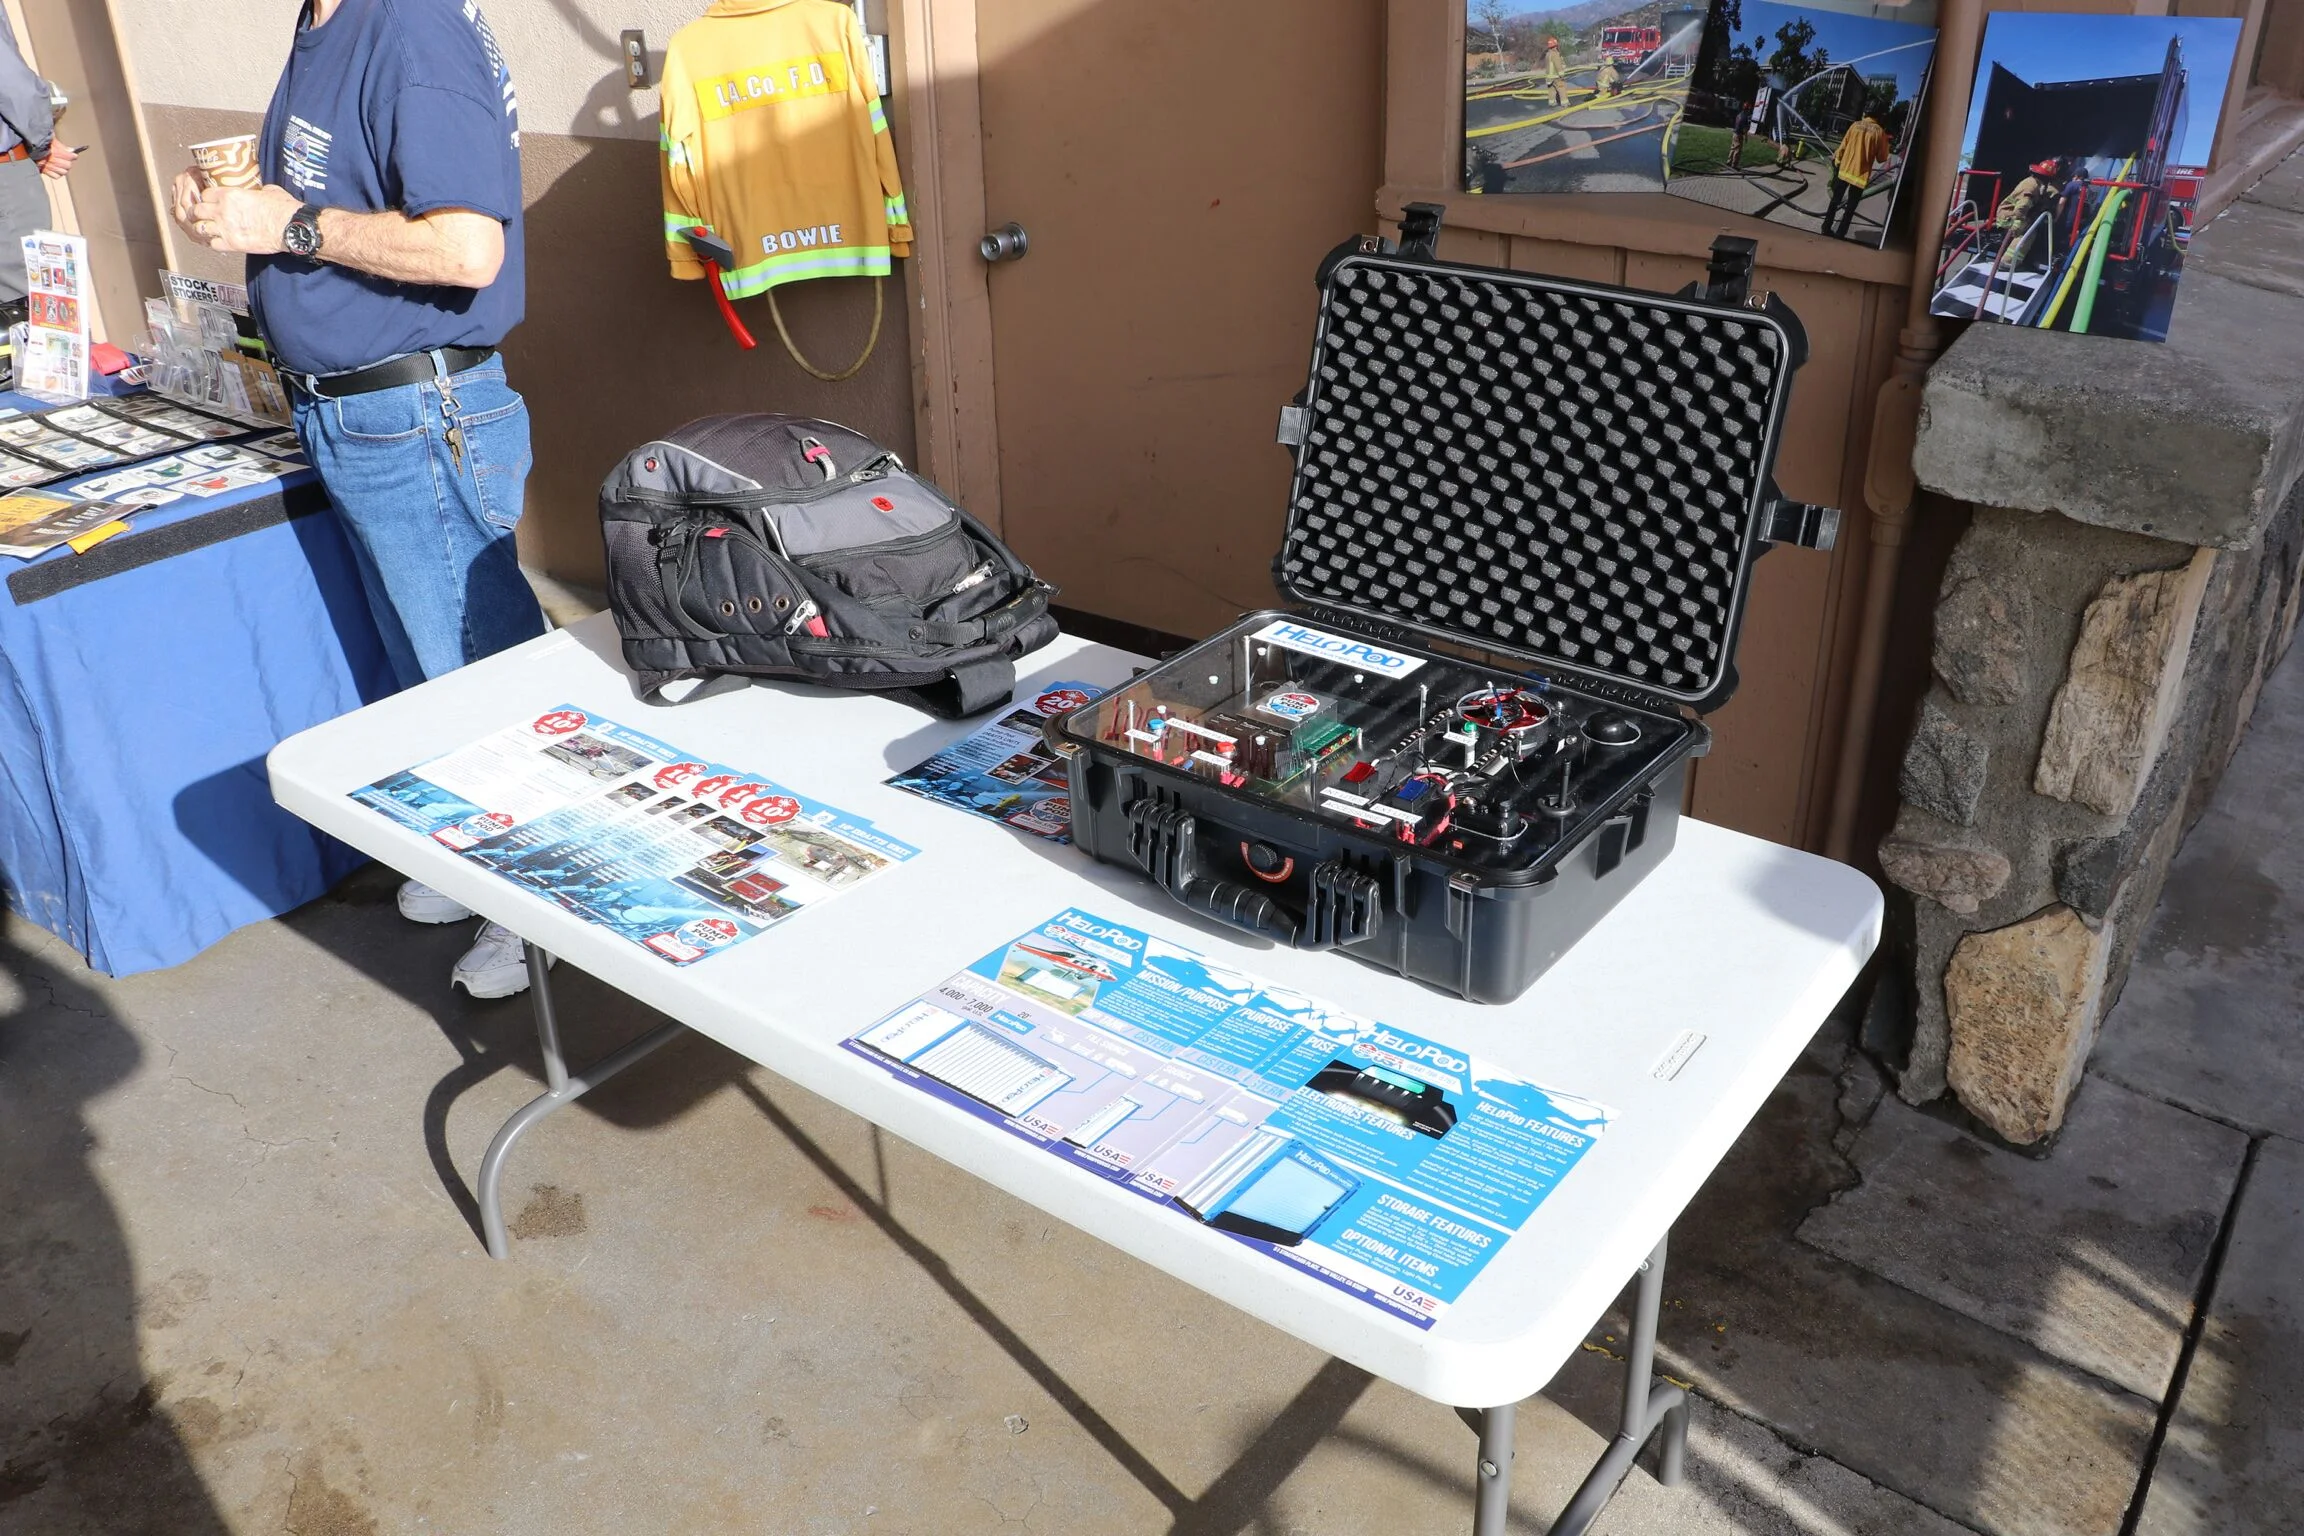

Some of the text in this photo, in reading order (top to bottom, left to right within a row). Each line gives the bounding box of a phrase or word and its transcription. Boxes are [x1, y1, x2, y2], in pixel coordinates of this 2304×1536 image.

[761, 224, 843, 254] BOWIE
[170, 276, 210, 292] STOCK
[173, 287, 215, 303] STICKERS
[541, 715, 581, 729] 10'
[1002, 737, 1021, 745] UNITS
[750, 801, 793, 817] 10'
[1043, 802, 1070, 813] PUM
[1043, 807, 1070, 817] POD
[472, 820, 495, 832] POD
[475, 816, 506, 830] PUMP
[689, 928, 718, 942] POD
[692, 922, 729, 940] PUMP
[1056, 911, 1144, 953] HELOPOD
[948, 975, 1012, 1005] CAPACITY
[1133, 969, 1234, 1012] MISSION/PURPOSE
[1016, 1011, 1033, 1020] 20'
[1131, 1029, 1179, 1053] CISTERN
[1367, 1025, 1468, 1074] HELOPOD
[1194, 1054, 1241, 1076] CISTERN
[1294, 1085, 1365, 1119] ELECTRONICS
[1360, 1114, 1418, 1140] FEATURES
[1021, 1114, 1050, 1131] USA
[1474, 1100, 1528, 1126] HELOPOD
[1522, 1118, 1587, 1148] FEATURES
[1091, 1144, 1122, 1161] USA
[1294, 1149, 1331, 1175] HELOPOD
[1374, 1192, 1434, 1224] STORAGE
[1427, 1215, 1493, 1249] FEATURES
[1339, 1226, 1402, 1261] OPTIONAL
[1396, 1252, 1441, 1278] ITEMS
[1390, 1285, 1427, 1306] USA
